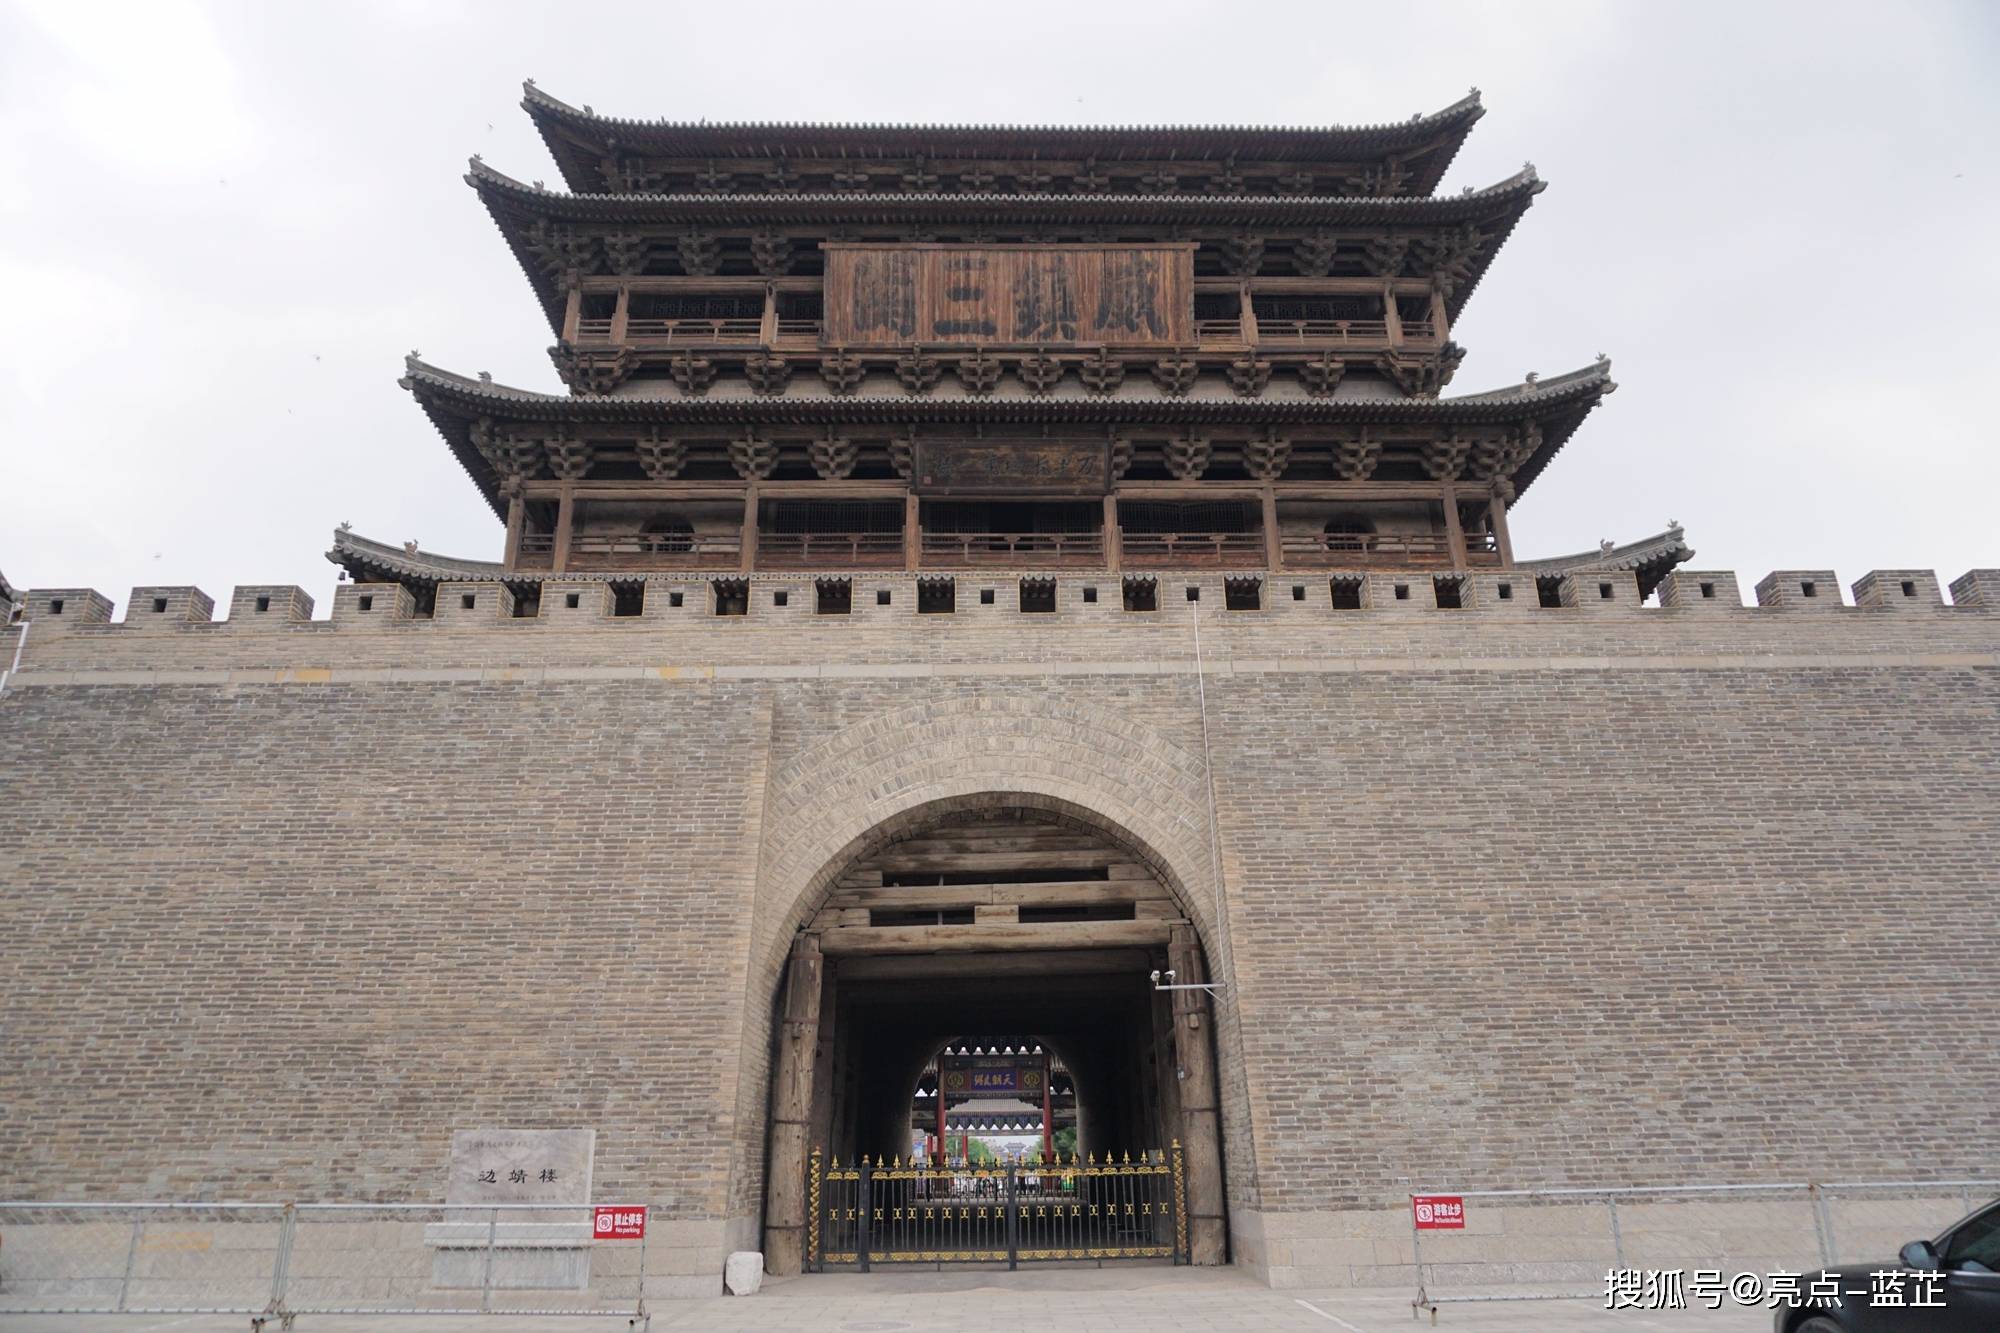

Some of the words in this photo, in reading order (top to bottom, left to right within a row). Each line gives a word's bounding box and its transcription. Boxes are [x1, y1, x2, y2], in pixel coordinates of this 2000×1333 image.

[478, 1168, 558, 1184] 边靖楼
[614, 1213, 642, 1225] 禁止停车
